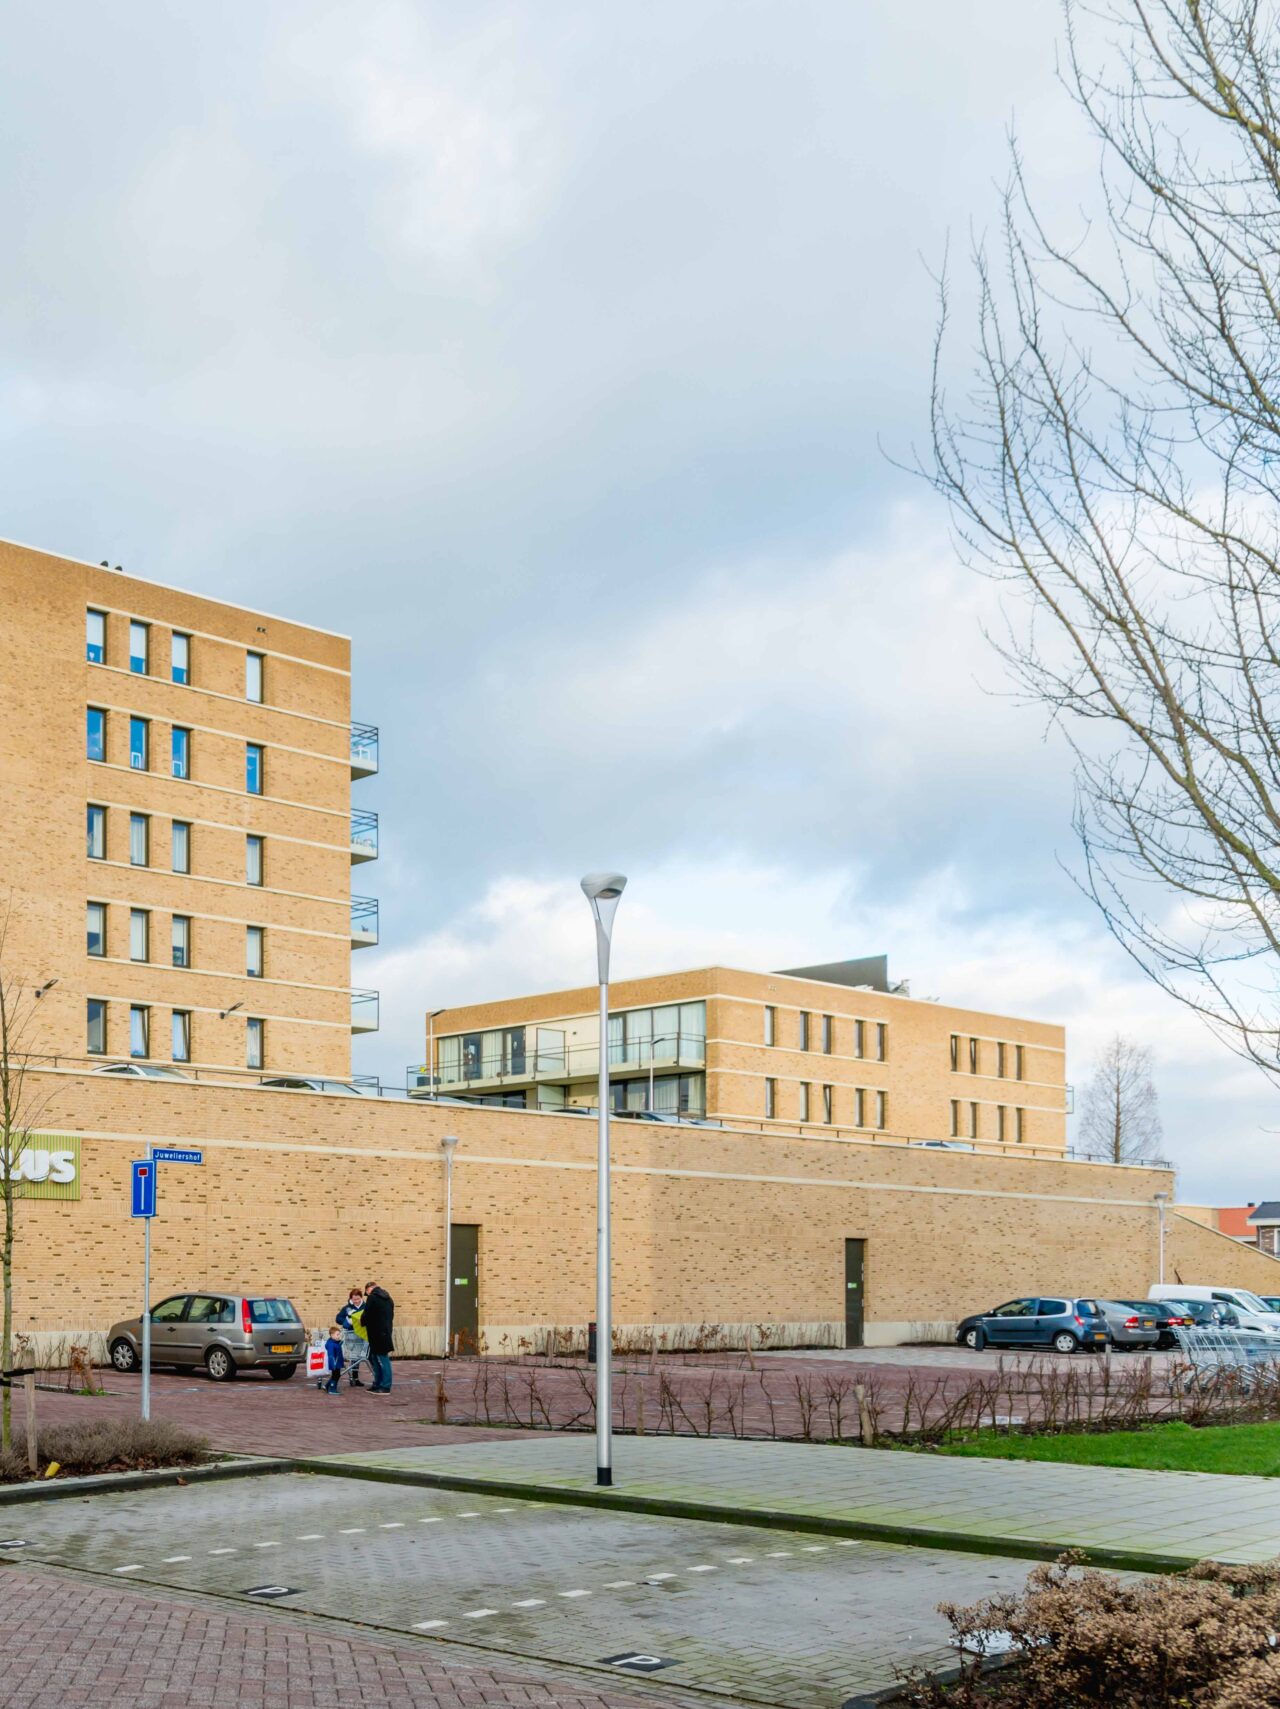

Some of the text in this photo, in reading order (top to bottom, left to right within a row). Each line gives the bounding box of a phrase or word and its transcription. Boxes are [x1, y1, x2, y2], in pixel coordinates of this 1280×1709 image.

[154, 1151, 200, 1161] Juweliershof
[248, 1586, 289, 1595] P
[611, 1655, 661, 1665] P
